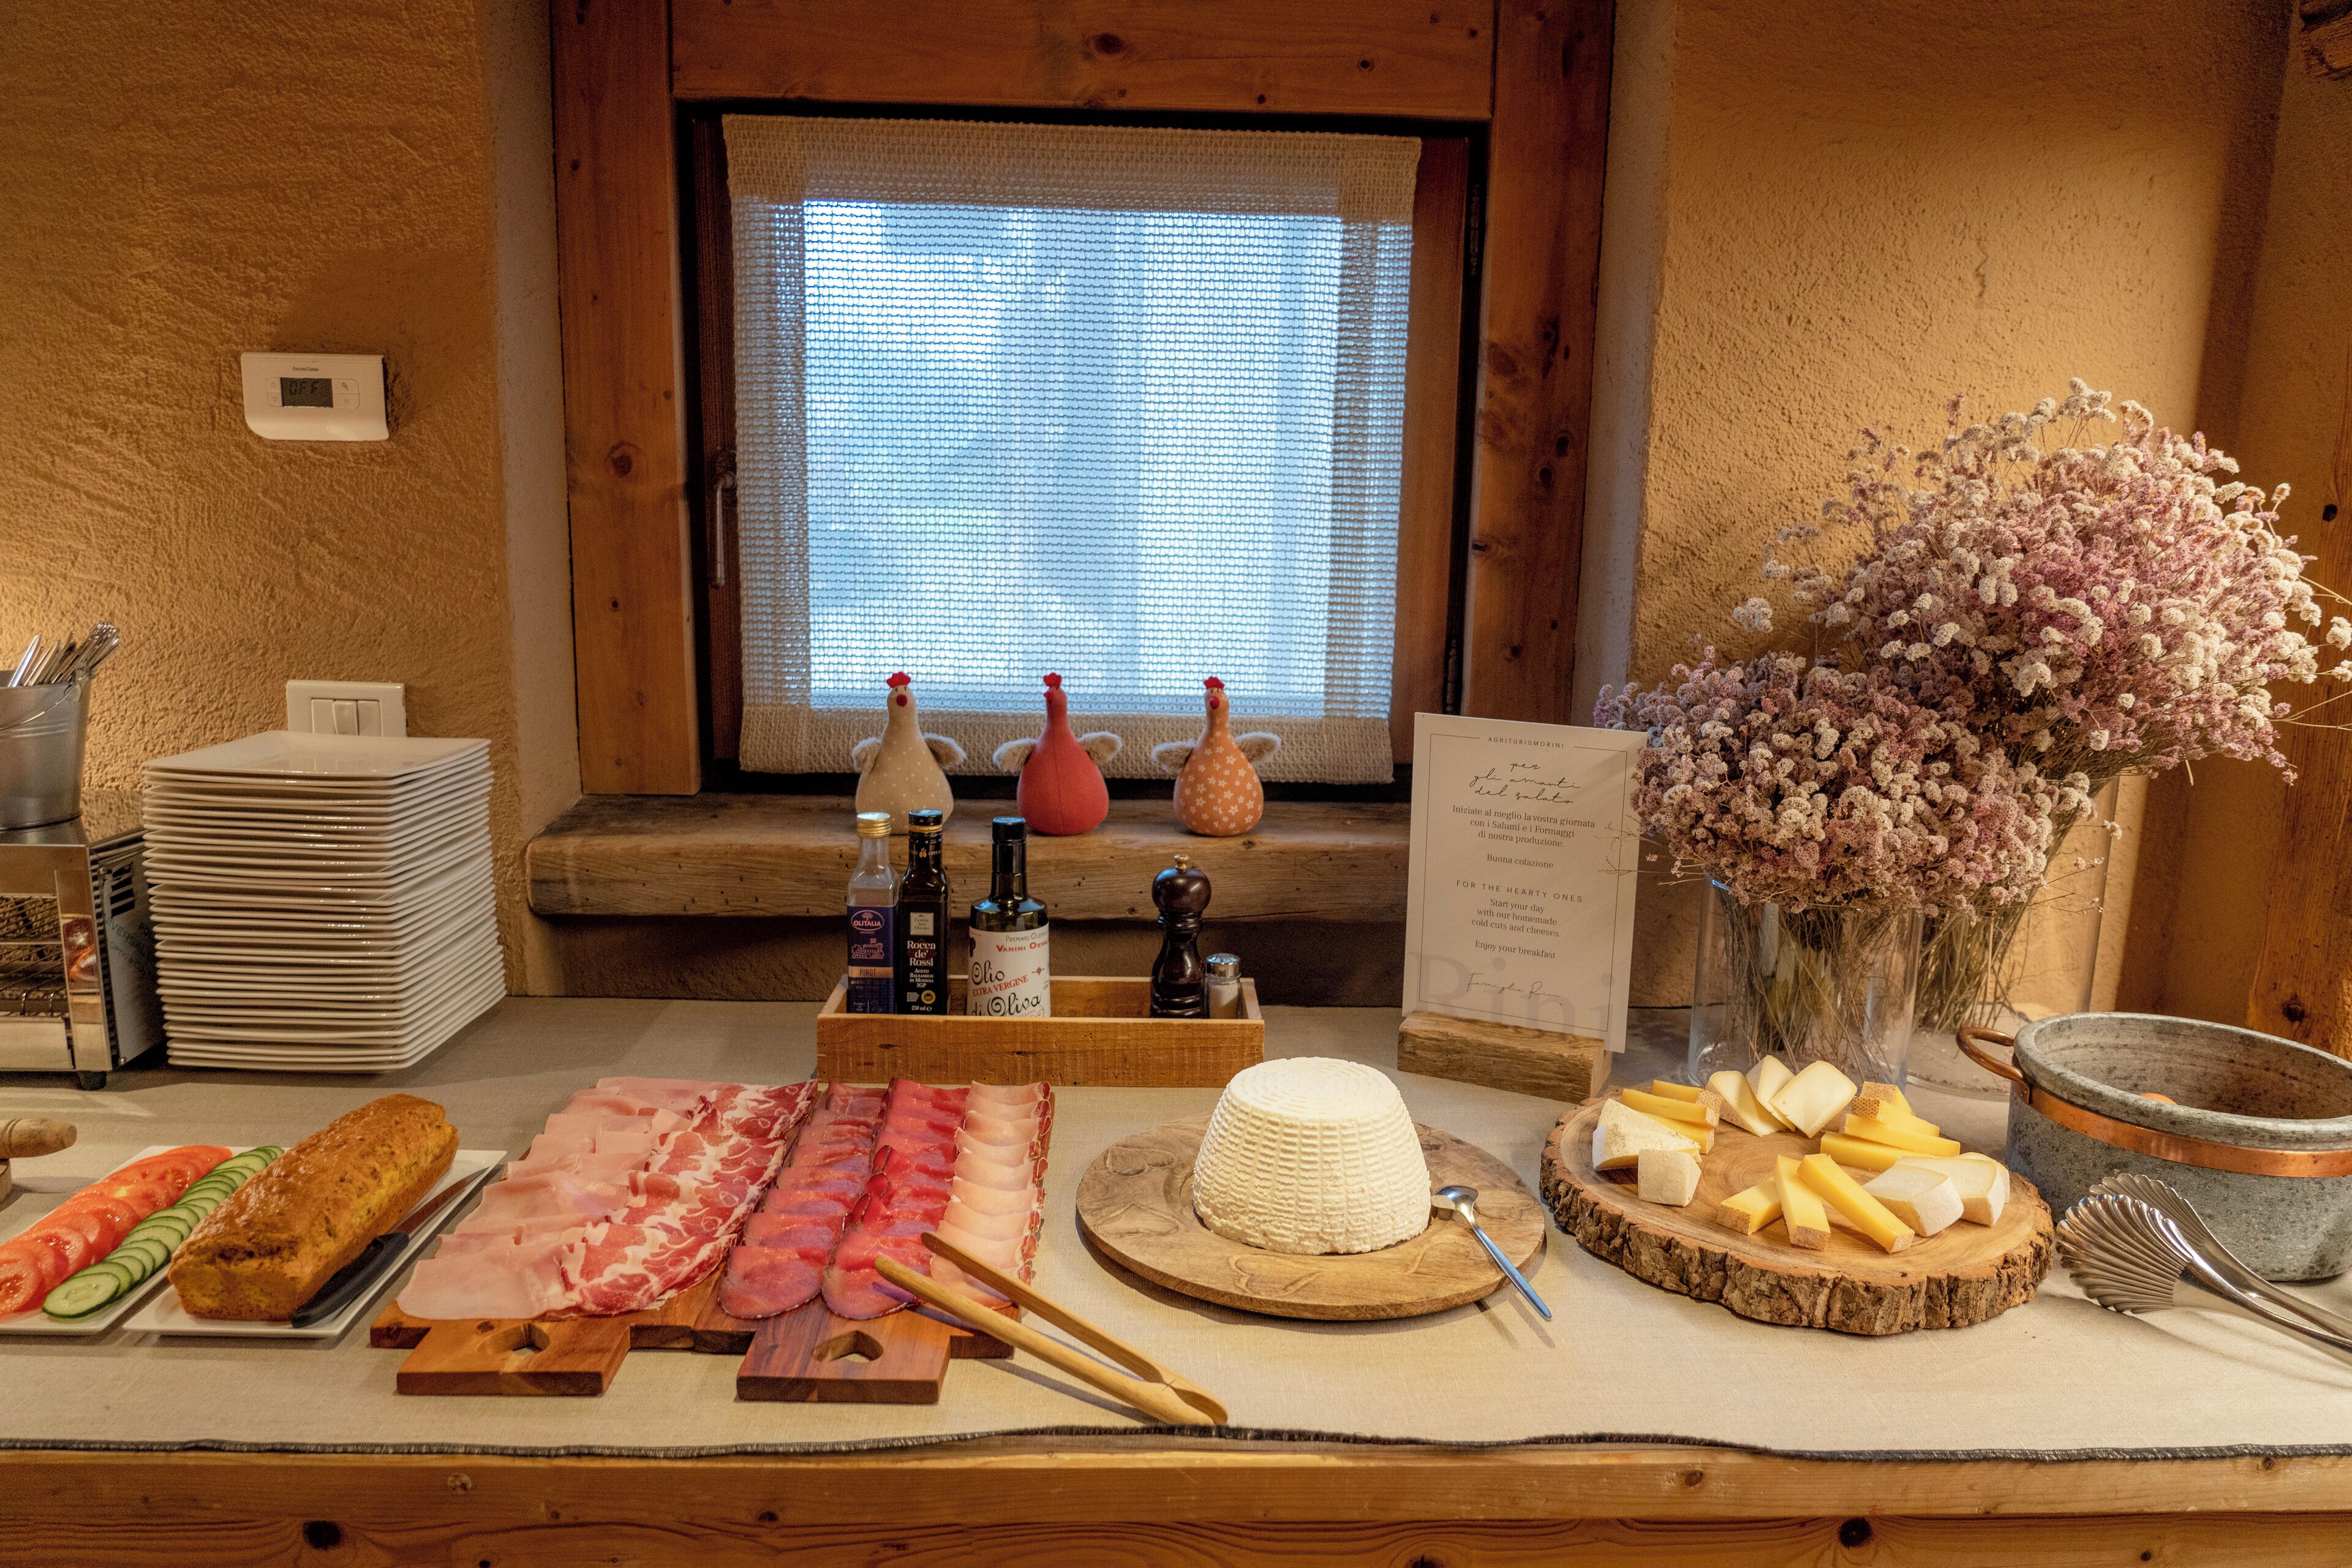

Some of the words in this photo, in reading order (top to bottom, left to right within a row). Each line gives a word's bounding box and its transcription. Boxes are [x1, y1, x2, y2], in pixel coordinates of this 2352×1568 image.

[1488, 737, 1564, 748] AGRITURISMORINI
[1510, 763, 1540, 772] per
[1469, 768, 1502, 787] gli
[1509, 777, 1581, 788] amanti
[1474, 785, 1508, 796] del
[1515, 788, 1574, 804] salato
[1452, 805, 1482, 815] Iniziate
[1494, 811, 1522, 820] meglio
[1559, 818, 1595, 827] giornata
[1492, 821, 1520, 831] Salumi
[1535, 826, 1574, 838] Formaggi
[1515, 836, 1565, 848] produzione.
[1487, 854, 1513, 864] Buona
[1515, 858, 1554, 869] colazione
[1482, 883, 1501, 892] THE
[1507, 887, 1547, 897] HEARTY
[1553, 892, 1583, 902] ONES
[1490, 899, 1509, 907] Start
[1531, 904, 1545, 914] day
[1512, 913, 1558, 925] homemade
[1526, 926, 1561, 937] cheeses.
[907, 940, 936, 949] Rocca
[1475, 940, 1497, 950] Enjoy
[1518, 946, 1556, 959] breakfast
[914, 949, 929, 958] de'
[910, 957, 933, 967] Rossi
[971, 960, 1005, 986] Olio
[972, 986, 993, 997] EXTRA
[993, 974, 1029, 992] VERGINE
[971, 1001, 982, 1016] di
[987, 992, 1041, 1017] Oliva
